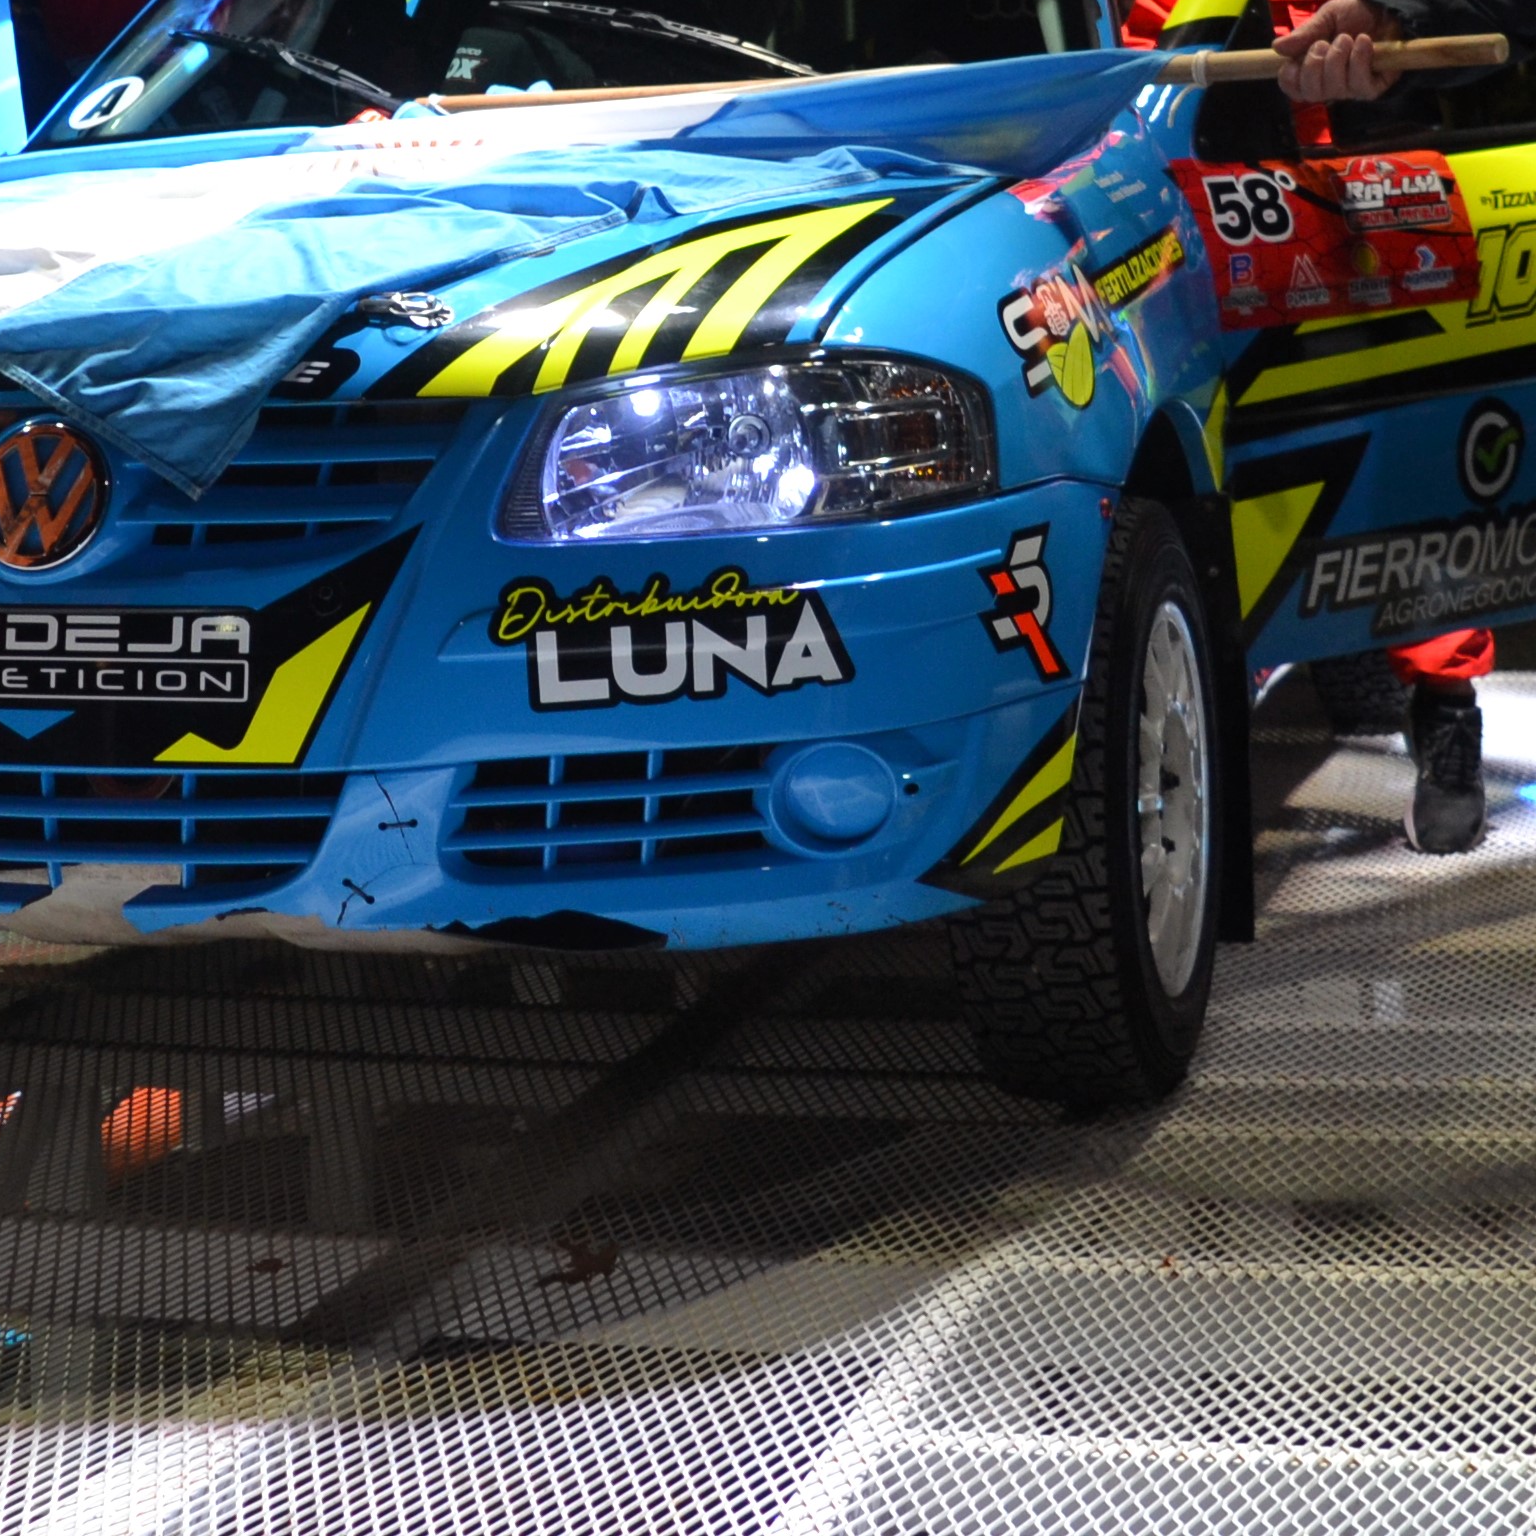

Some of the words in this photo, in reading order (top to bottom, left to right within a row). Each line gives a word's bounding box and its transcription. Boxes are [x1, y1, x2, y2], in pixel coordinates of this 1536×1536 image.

[1344, 171, 1445, 203] RALLY
[498, 572, 798, 640] Distribuidora
[535, 600, 844, 705] LUNA
